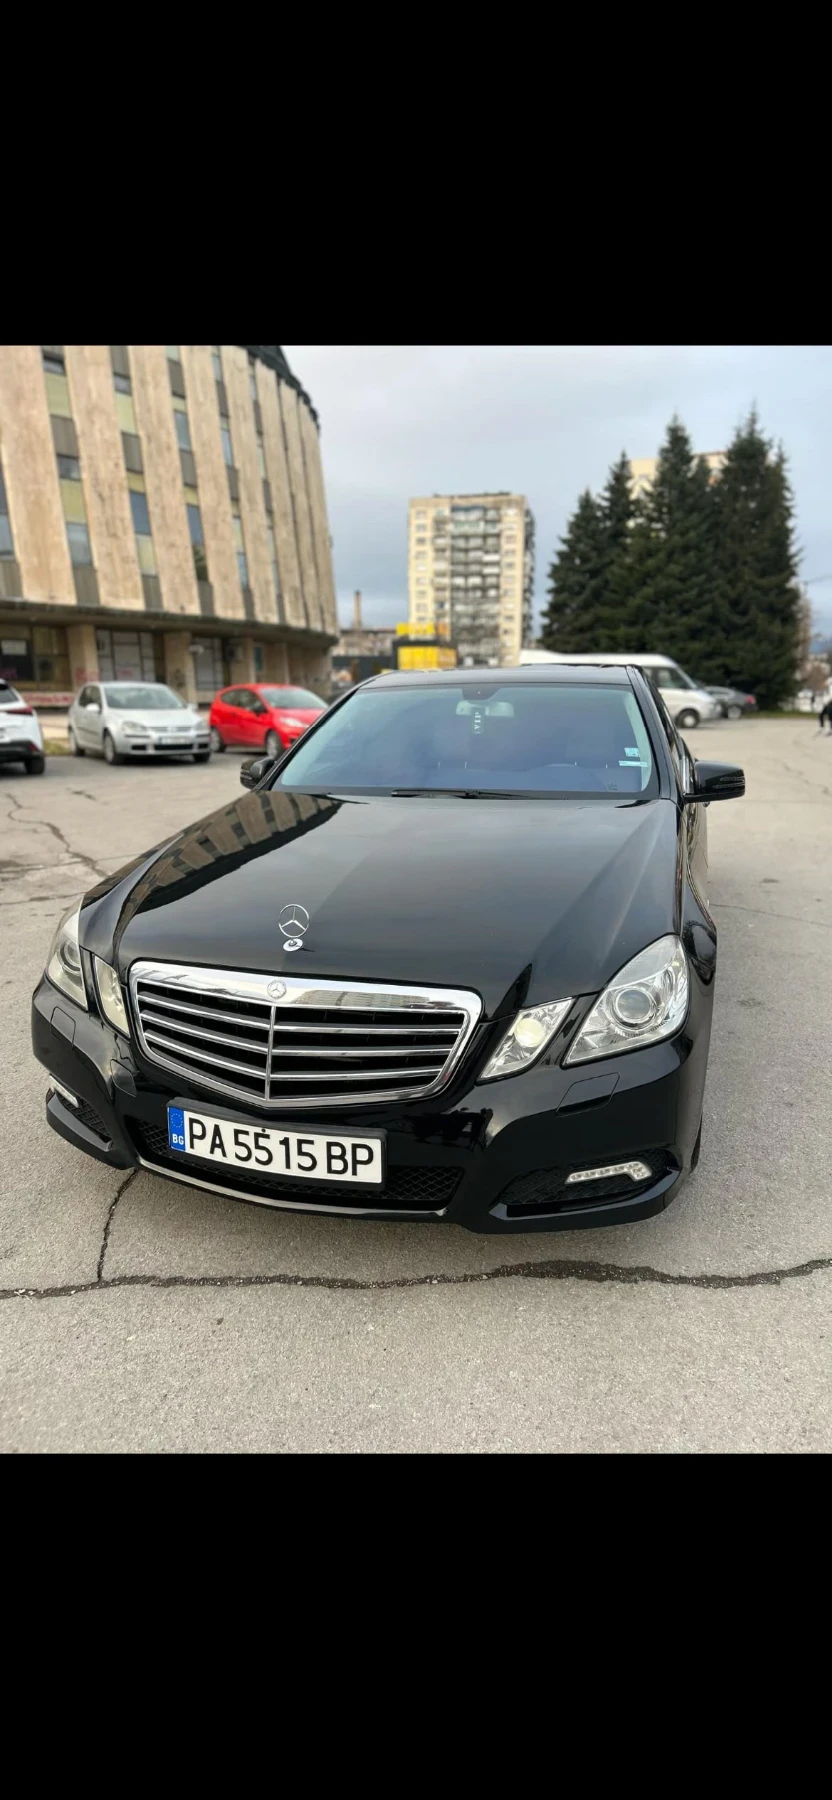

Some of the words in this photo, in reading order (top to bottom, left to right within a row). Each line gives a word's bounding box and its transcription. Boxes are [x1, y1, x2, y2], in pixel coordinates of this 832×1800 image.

[172, 1133, 184, 1145] BG
[188, 1117, 227, 1158] PA
[233, 1128, 317, 1171] 5515
[326, 1141, 374, 1176] BP
